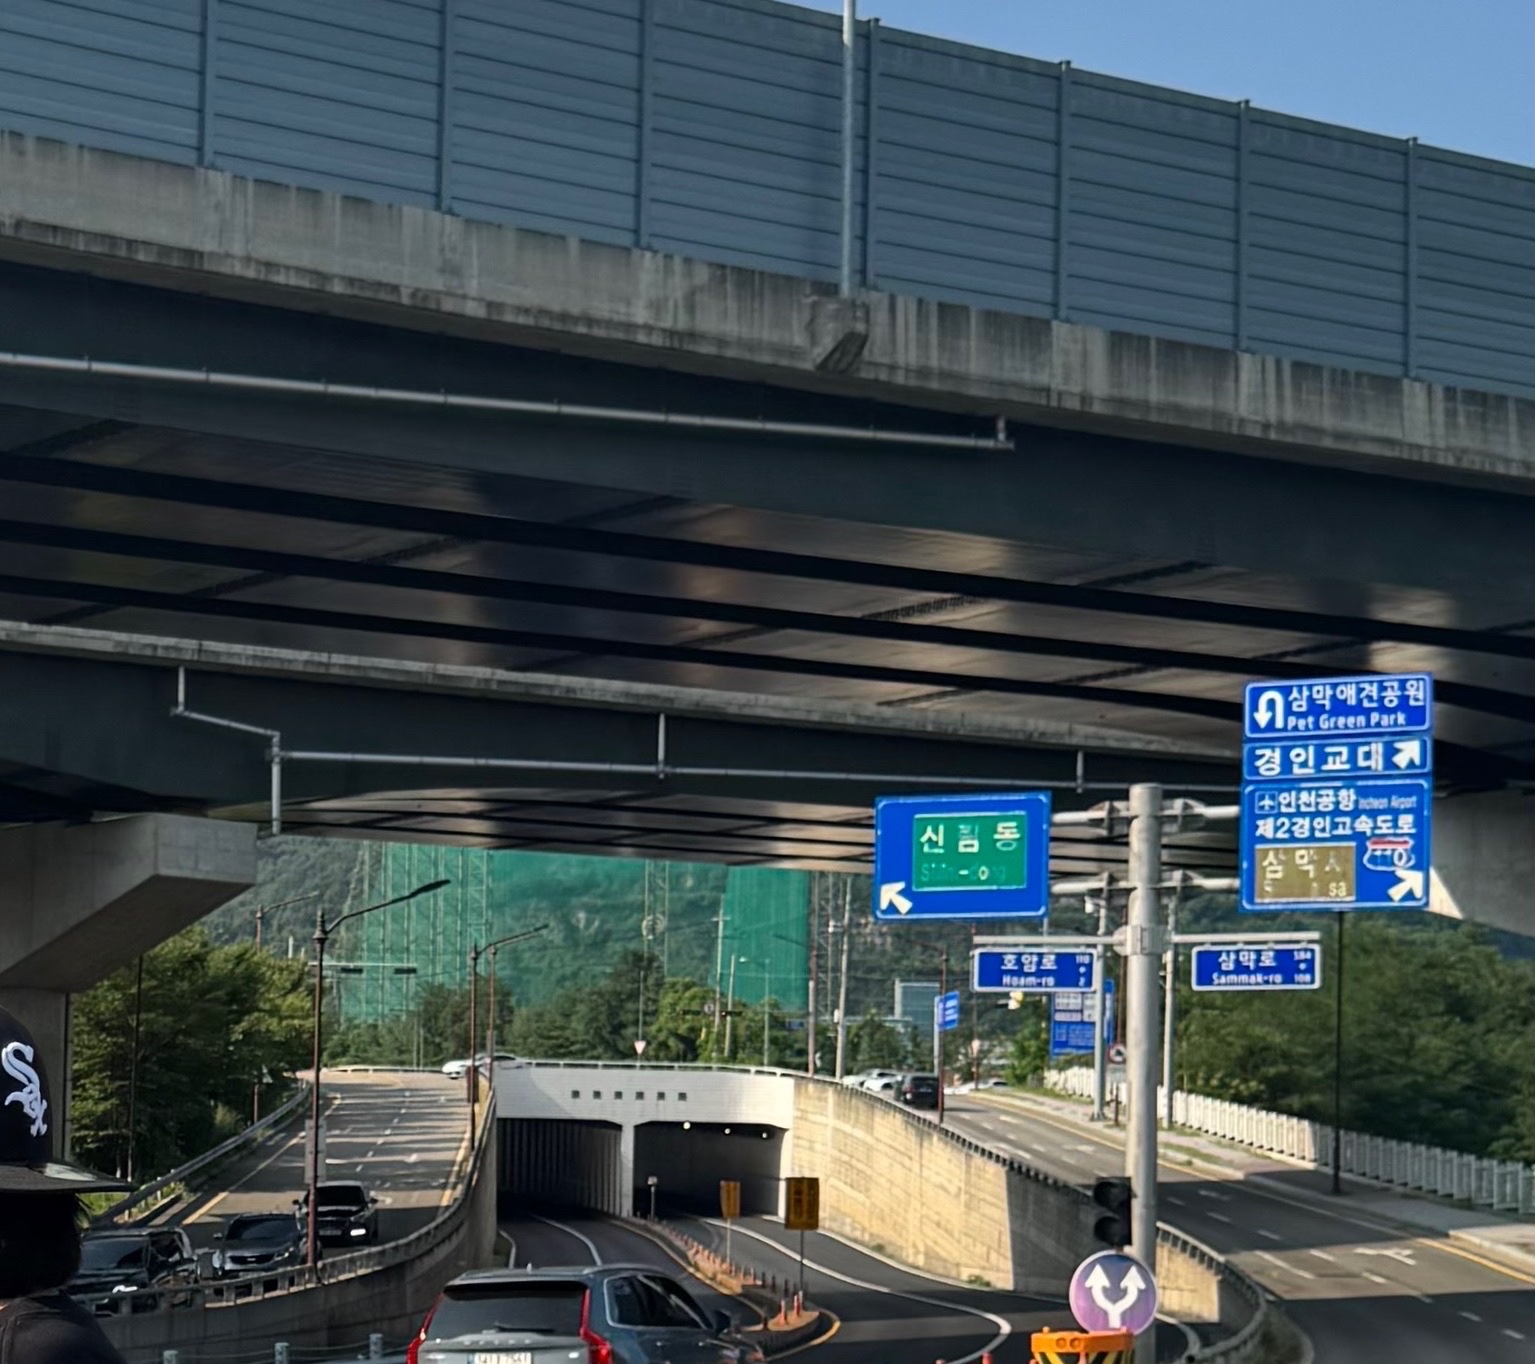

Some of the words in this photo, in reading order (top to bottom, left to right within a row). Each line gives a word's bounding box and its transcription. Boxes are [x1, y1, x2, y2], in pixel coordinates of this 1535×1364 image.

[1287, 679, 1426, 713] 삼막애견공원
[1287, 716, 1315, 731] Pet
[1319, 713, 1366, 730] Green
[1370, 711, 1407, 727] Park
[1254, 740, 1385, 777] 경인교대
[1278, 788, 1357, 813] 인천공항
[1255, 814, 1417, 840] 제2경인고속도로
[1000, 954, 1058, 973] 호암로
[1217, 950, 1277, 971] 삼막로
[1002, 975, 1055, 987] Hoam-ro
[1212, 972, 1283, 985] Sammak-ro
[1, 1041, 48, 1137] Sox
